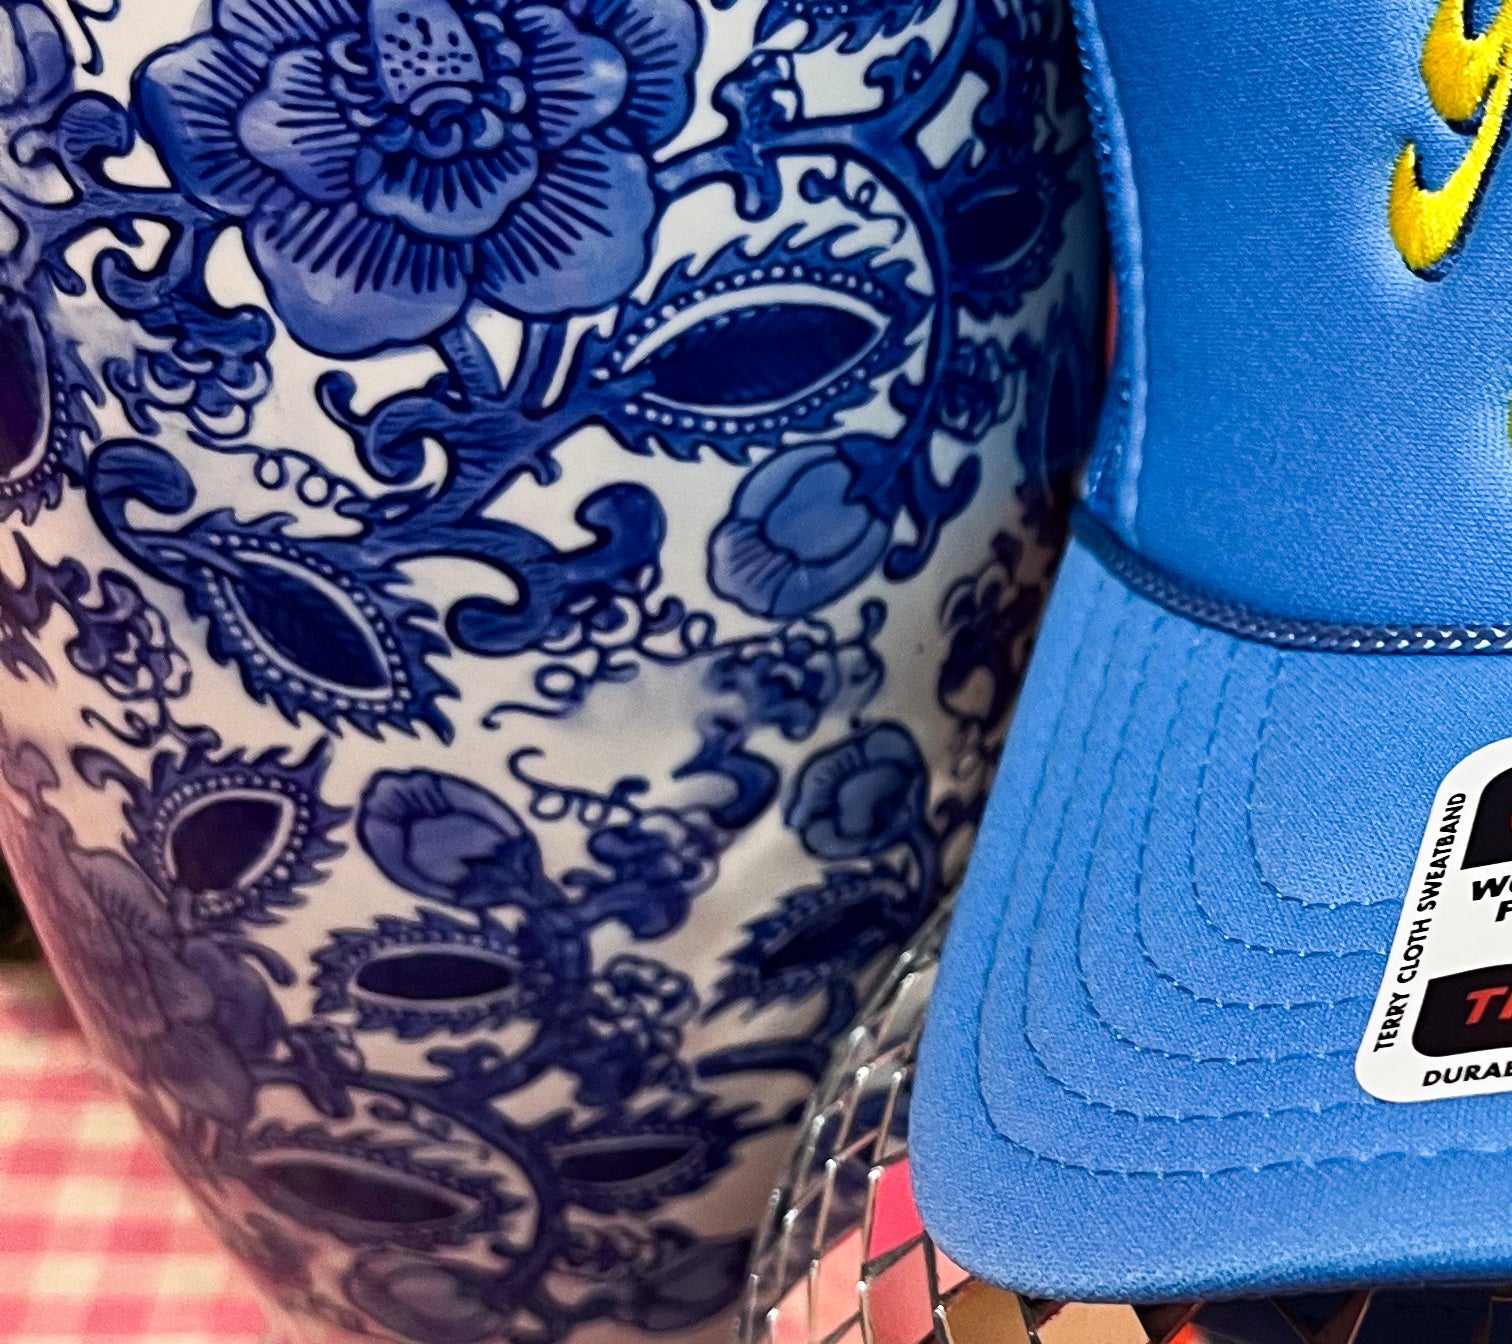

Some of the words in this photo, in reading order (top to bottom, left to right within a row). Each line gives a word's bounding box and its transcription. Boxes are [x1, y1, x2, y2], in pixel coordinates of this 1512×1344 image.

[1374, 992, 1412, 1052] TERRY
[1398, 918, 1431, 983] CLOTH
[1418, 792, 1466, 912] SWEATBAND
